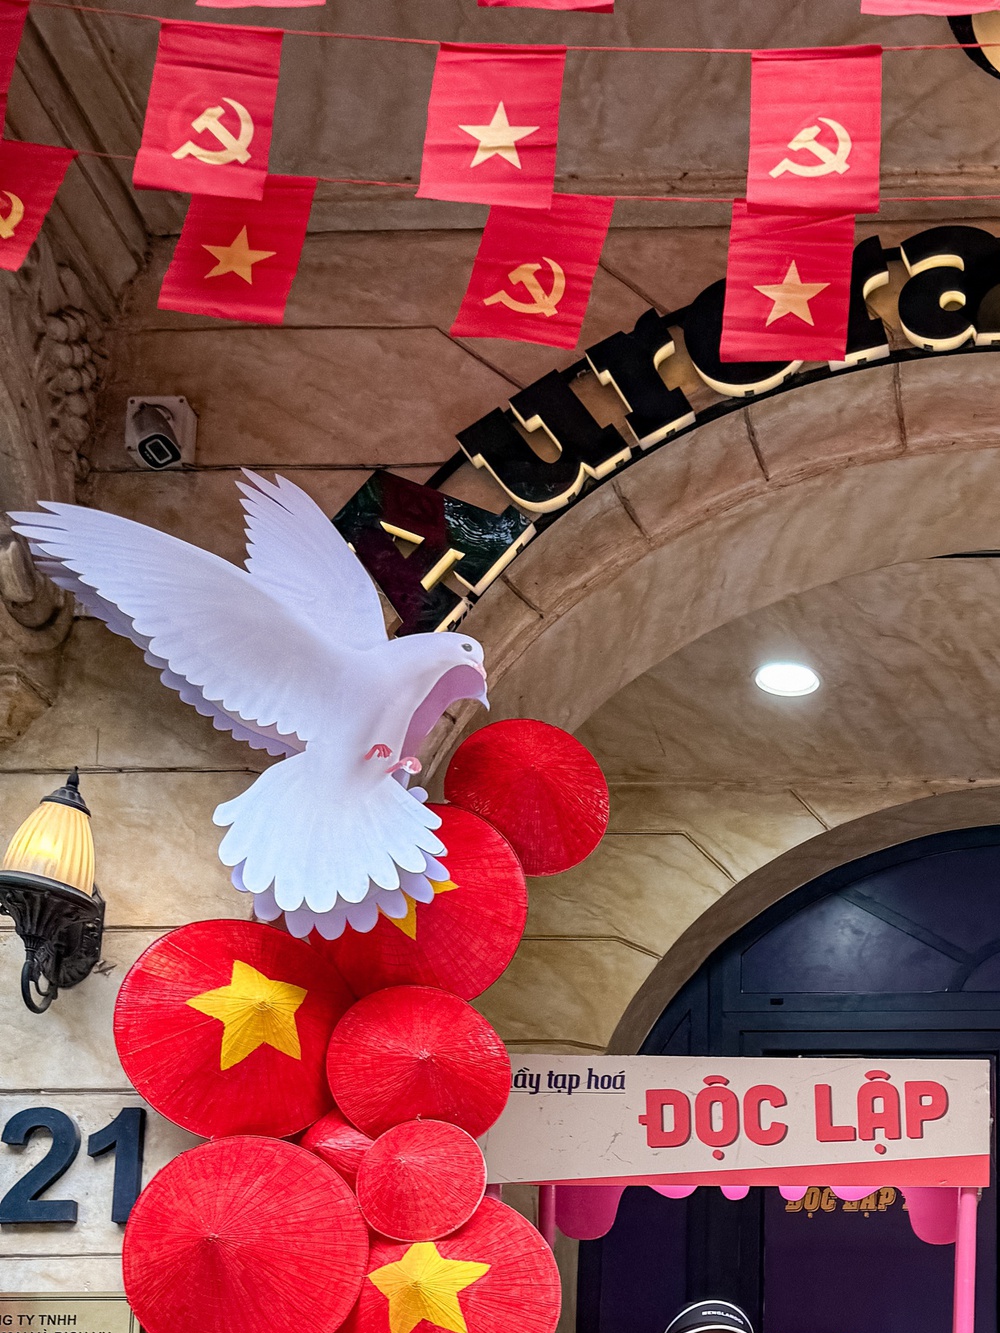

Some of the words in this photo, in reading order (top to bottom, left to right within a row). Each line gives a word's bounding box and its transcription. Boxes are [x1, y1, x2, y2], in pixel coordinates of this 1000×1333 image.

[547, 1071, 580, 1095] tạp
[586, 1068, 625, 1090] hoá
[639, 1075, 788, 1160] ĐỘC
[814, 1070, 950, 1155] LẬP
[17, 1315, 36, 1326] TY
[39, 1315, 77, 1326] TNHH
